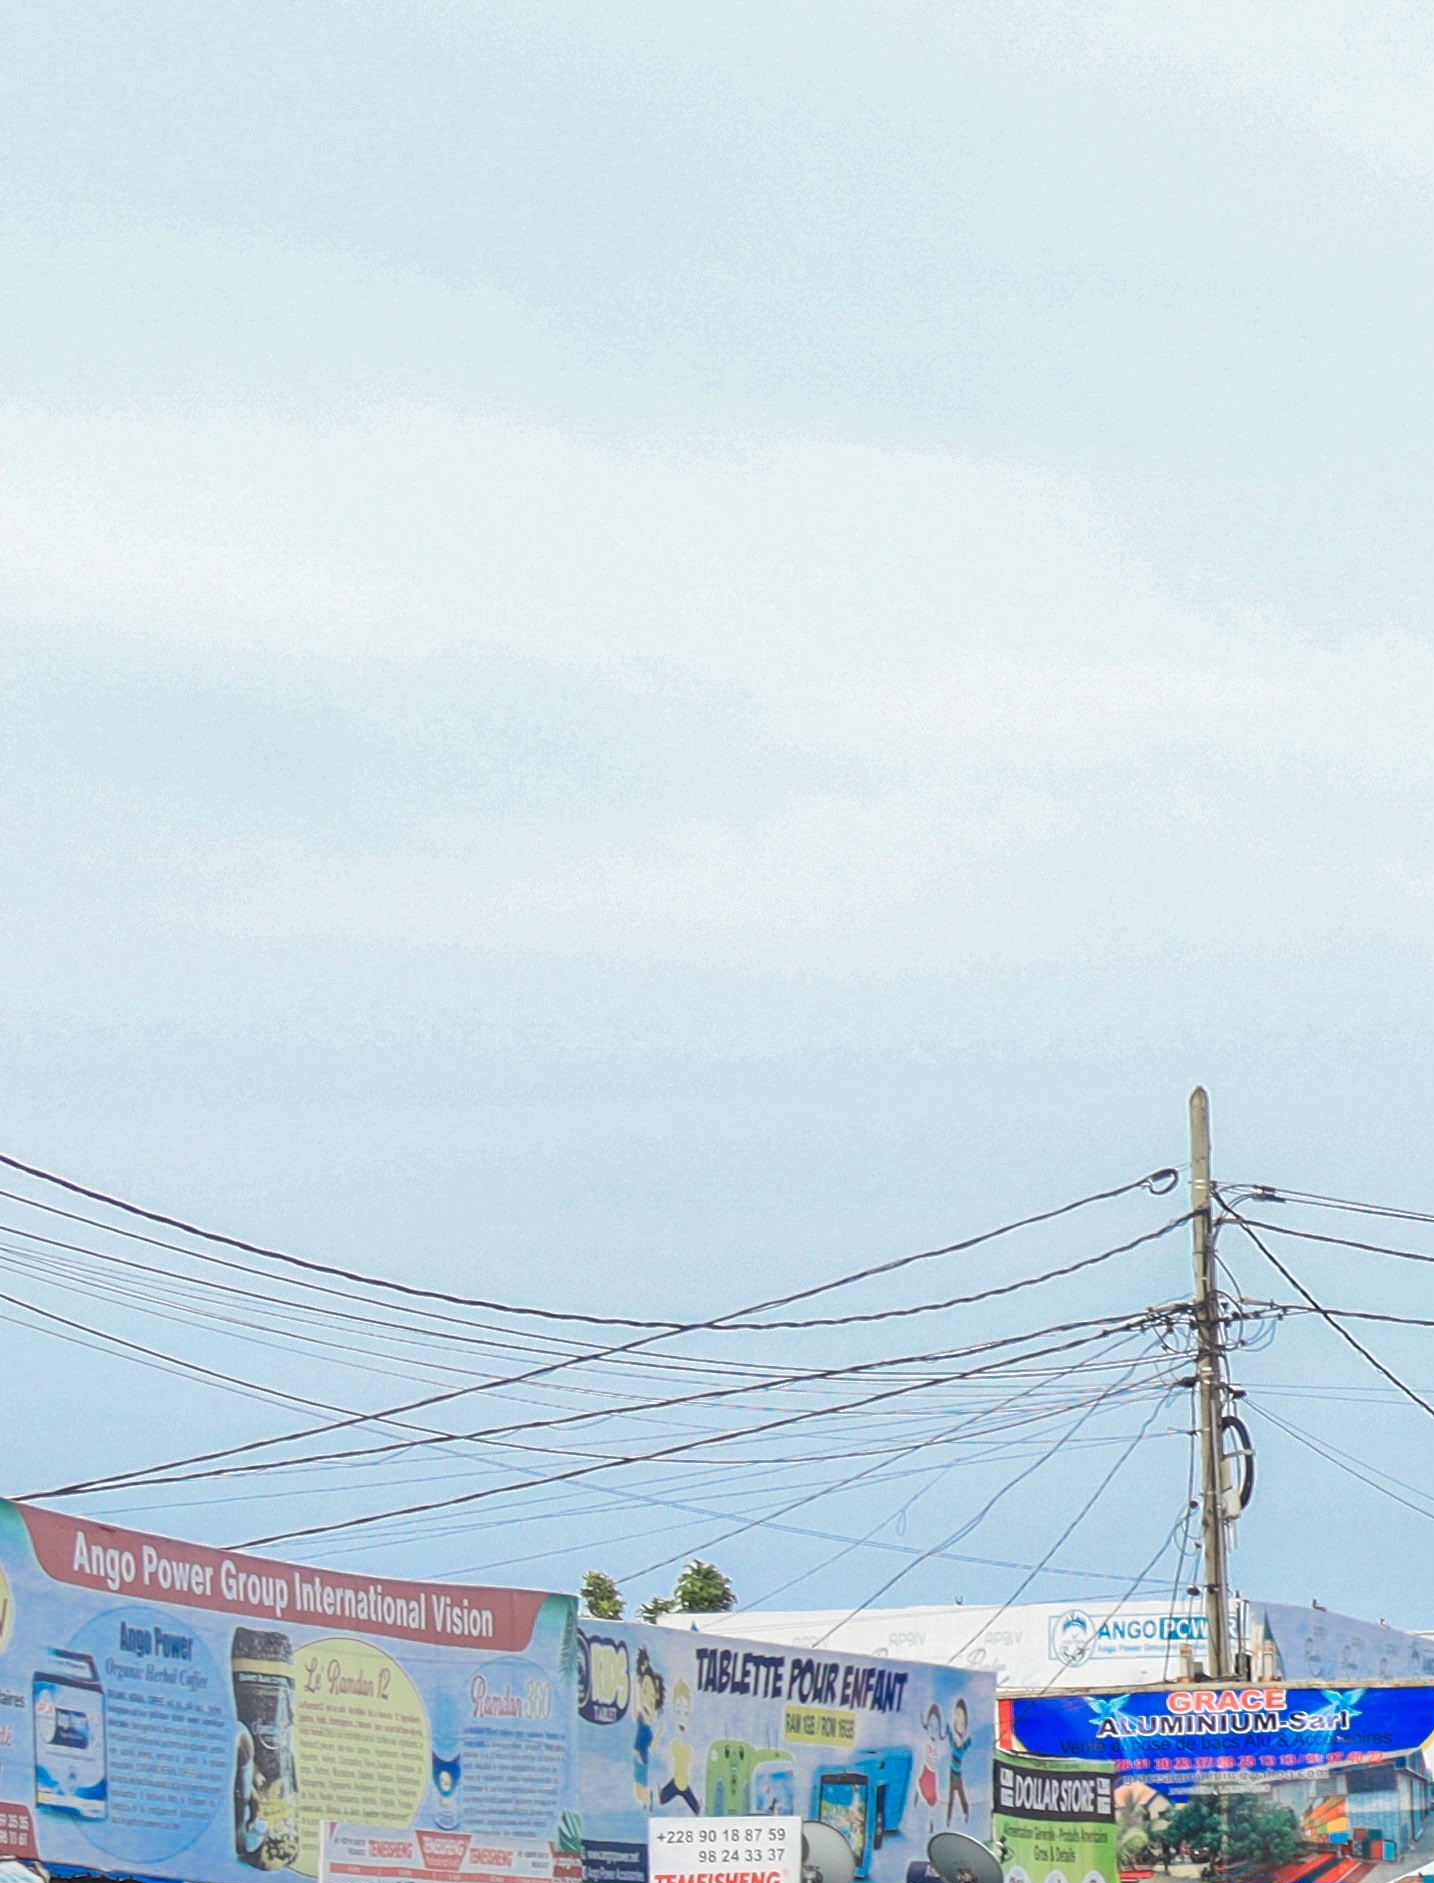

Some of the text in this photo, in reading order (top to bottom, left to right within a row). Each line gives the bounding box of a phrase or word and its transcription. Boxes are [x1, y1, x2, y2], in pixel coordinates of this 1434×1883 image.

[73, 1530, 494, 1638] Ango Power Group International Vision
[119, 1621, 193, 1661] Ango Power
[1096, 1616, 1240, 1640] ANGO POWR
[105, 1657, 209, 1692] Organic Herbal Coffee
[327, 1659, 374, 1696] Ramdan
[695, 1647, 910, 1713] TABLETTE POUR ENFANT
[471, 1675, 523, 1717] Ramdan
[1166, 1688, 1288, 1714] GRACE
[1097, 1709, 1351, 1739] ALUMINIUM-Sarl
[1175, 1734, 1195, 1751] de
[1203, 1733, 1240, 1751] bacs
[1244, 1731, 1274, 1749] Alu
[1278, 1732, 1289, 1747] &
[1015, 1773, 1096, 1813] DOLLAR STORE
[656, 1828, 786, 1845] +228 90 18 87 59
[698, 1848, 785, 1864] 98 24 33 37
